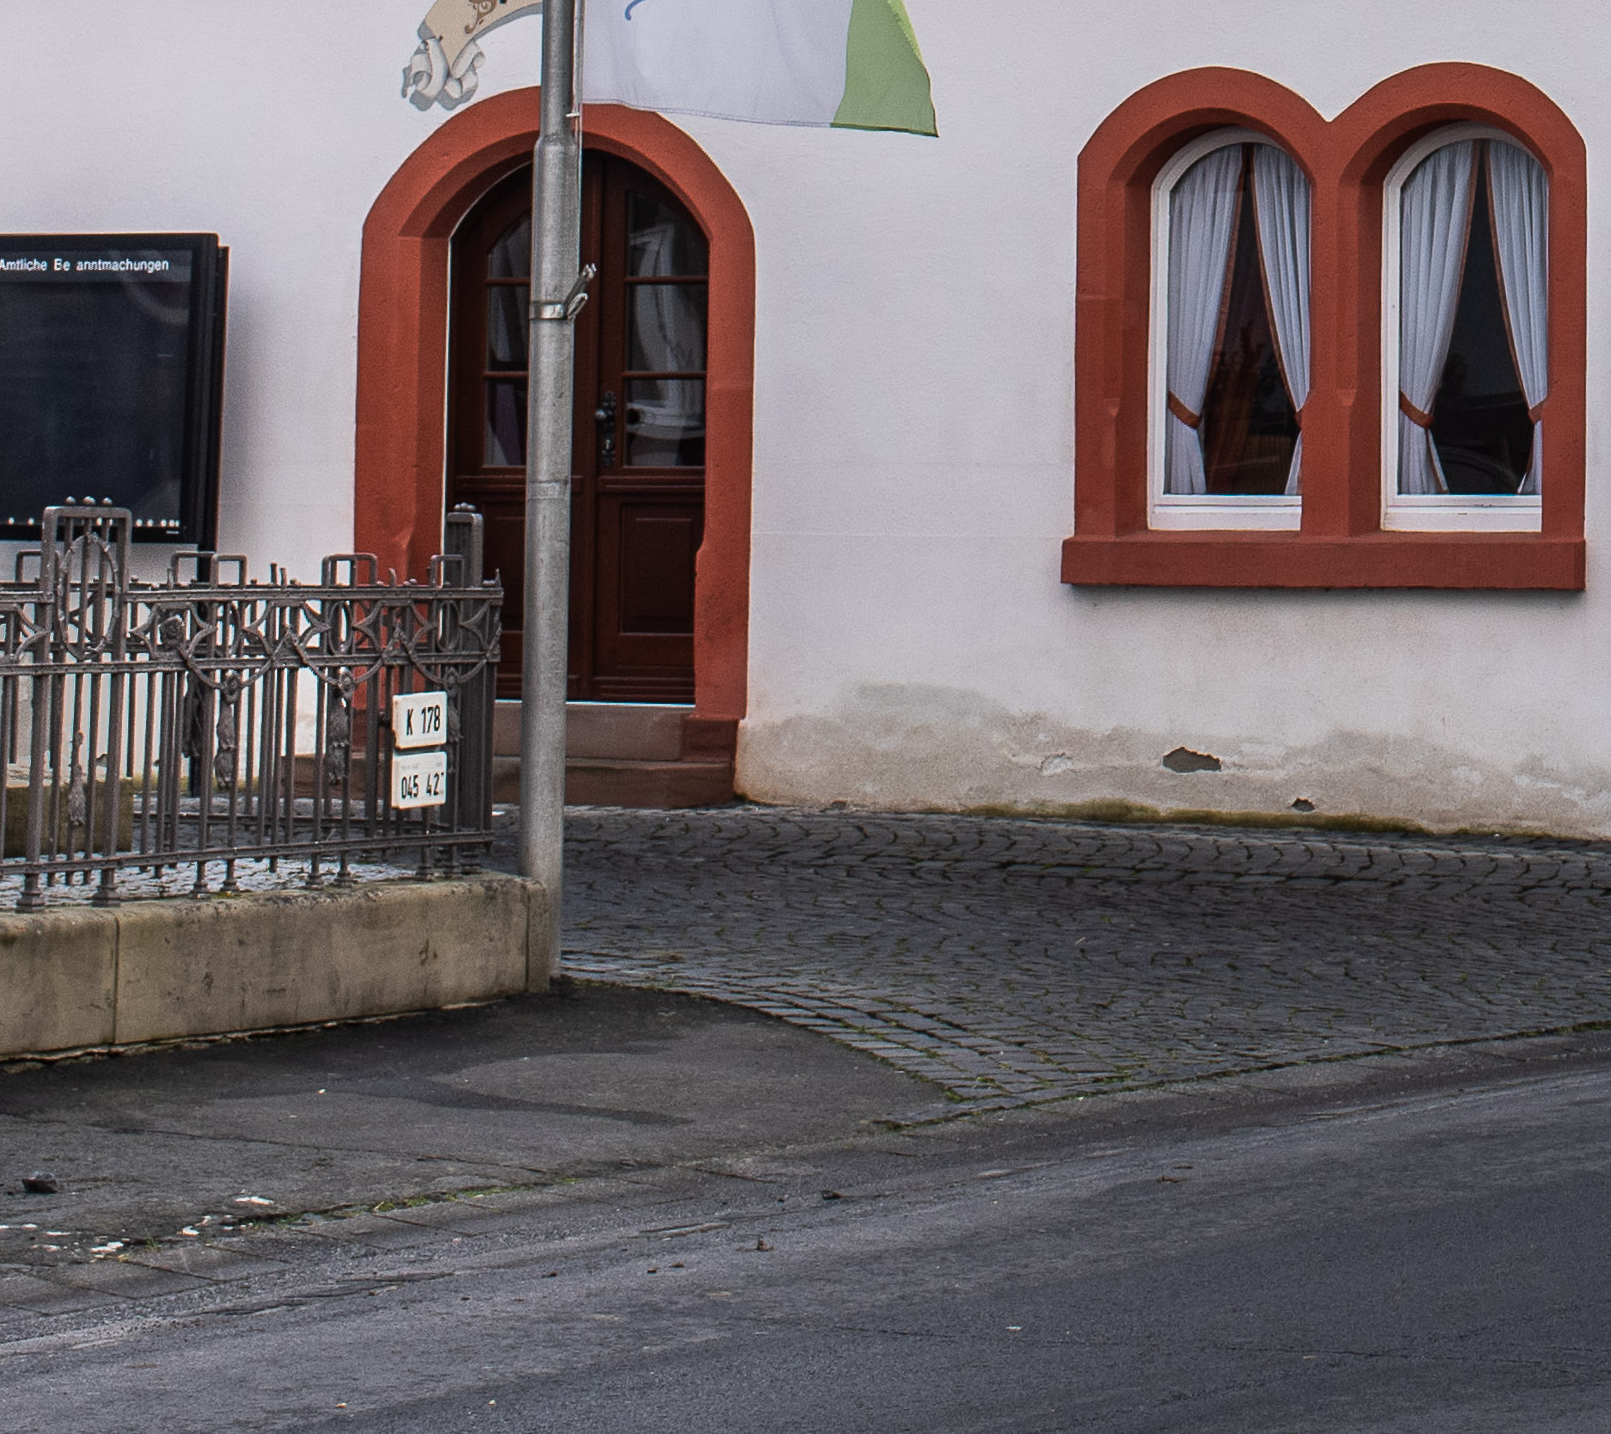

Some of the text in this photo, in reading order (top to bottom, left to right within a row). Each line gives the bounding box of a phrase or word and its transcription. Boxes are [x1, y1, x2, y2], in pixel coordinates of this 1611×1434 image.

[406, 705, 440, 736] K 178
[401, 774, 419, 799] 045
